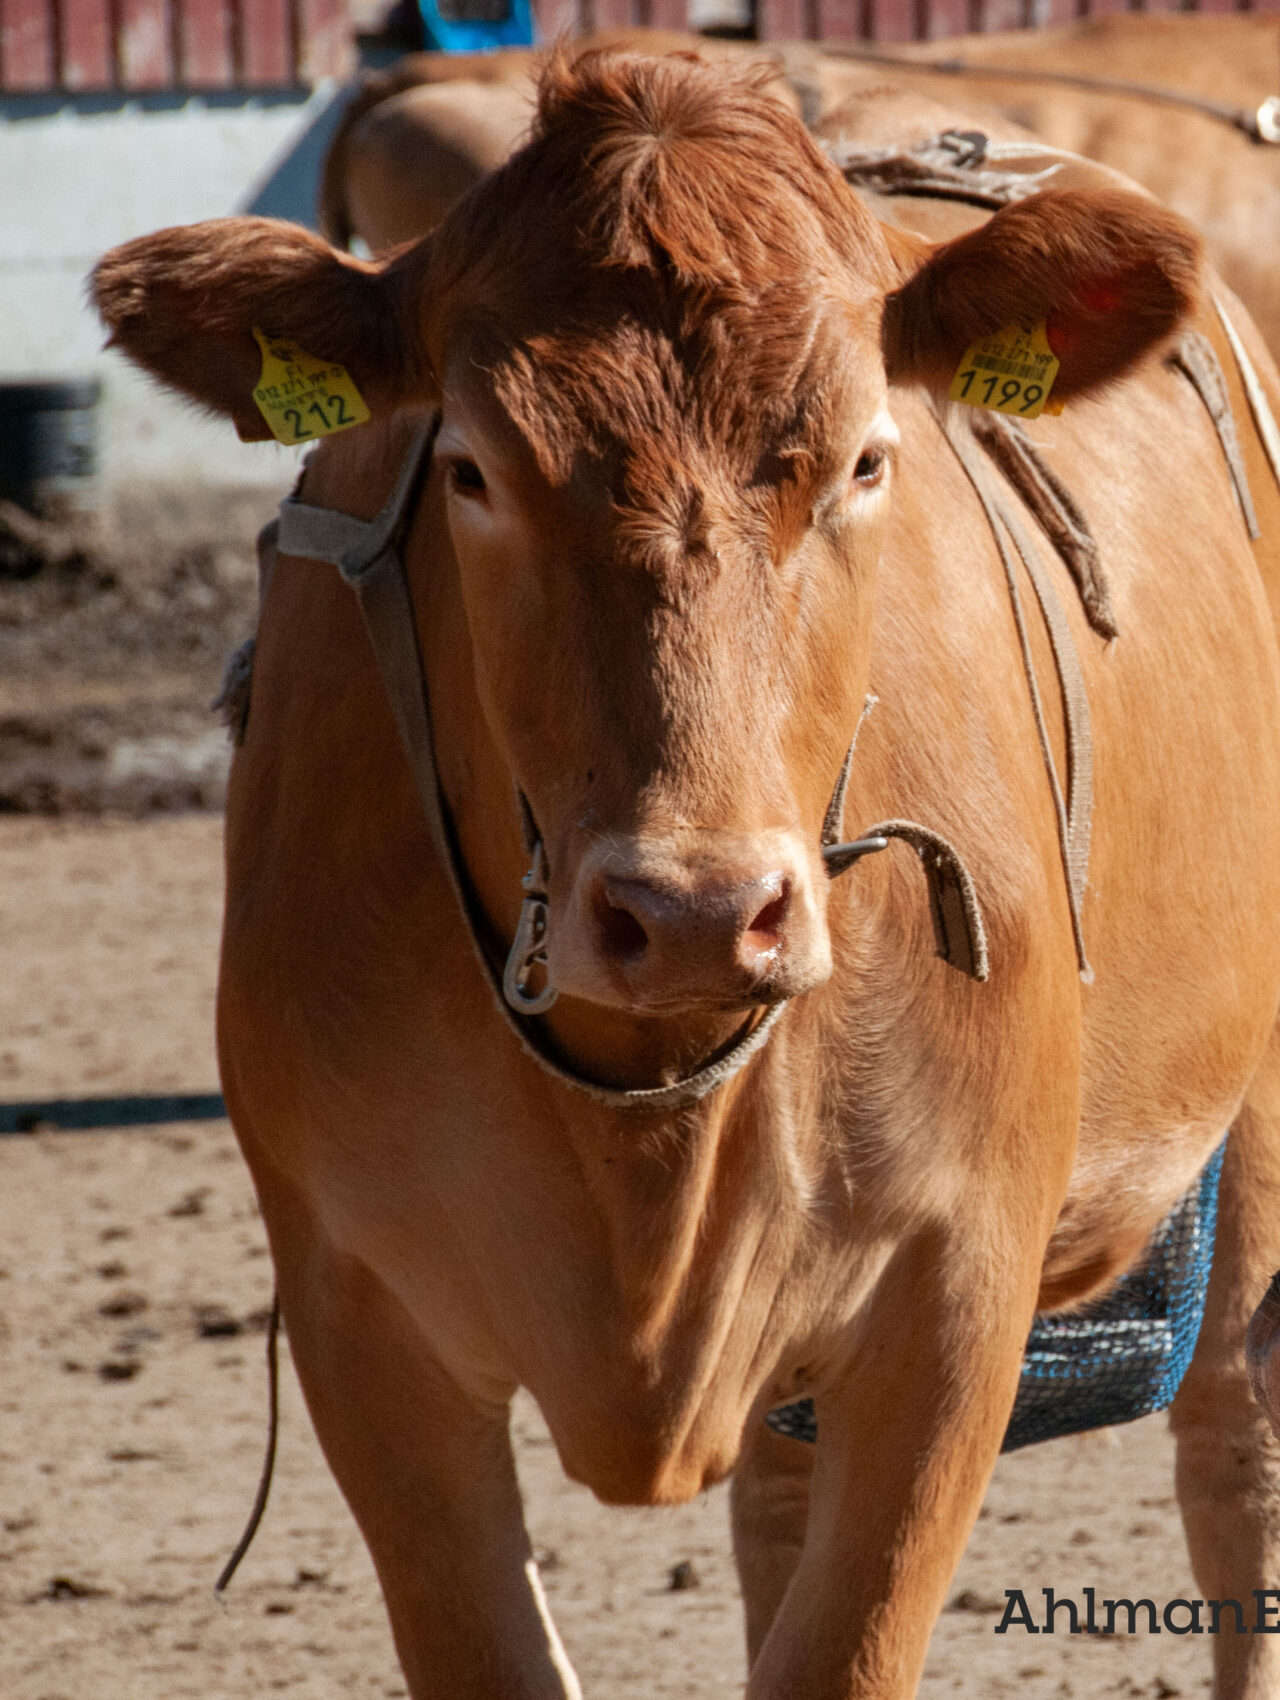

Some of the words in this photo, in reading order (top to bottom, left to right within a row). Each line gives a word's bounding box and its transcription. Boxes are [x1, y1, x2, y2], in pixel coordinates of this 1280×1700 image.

[256, 385, 280, 401] 012
[960, 370, 1043, 412] 1199
[283, 395, 355, 438] 212
